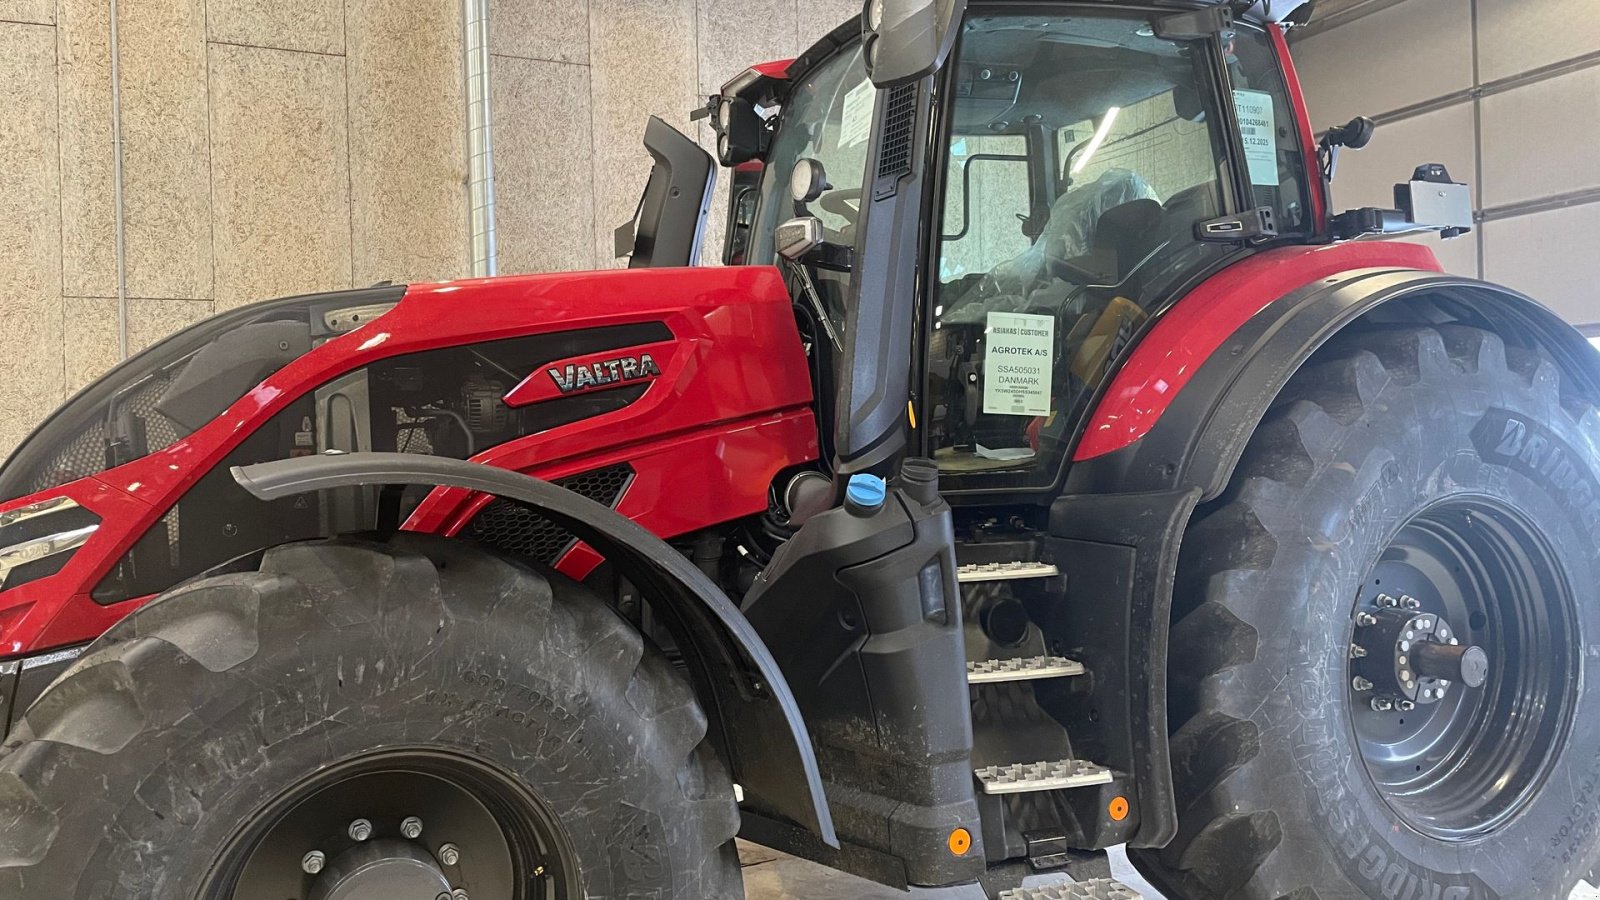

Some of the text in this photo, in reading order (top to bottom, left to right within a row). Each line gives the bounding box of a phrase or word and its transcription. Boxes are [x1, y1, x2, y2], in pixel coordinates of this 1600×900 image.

[1021, 329, 1048, 337] CUSTOMER
[991, 346, 1048, 357] AGROTEK A/S
[548, 354, 660, 391] VALTRA
[997, 365, 1040, 375] SSA505031
[998, 376, 1039, 385] DANMARK
